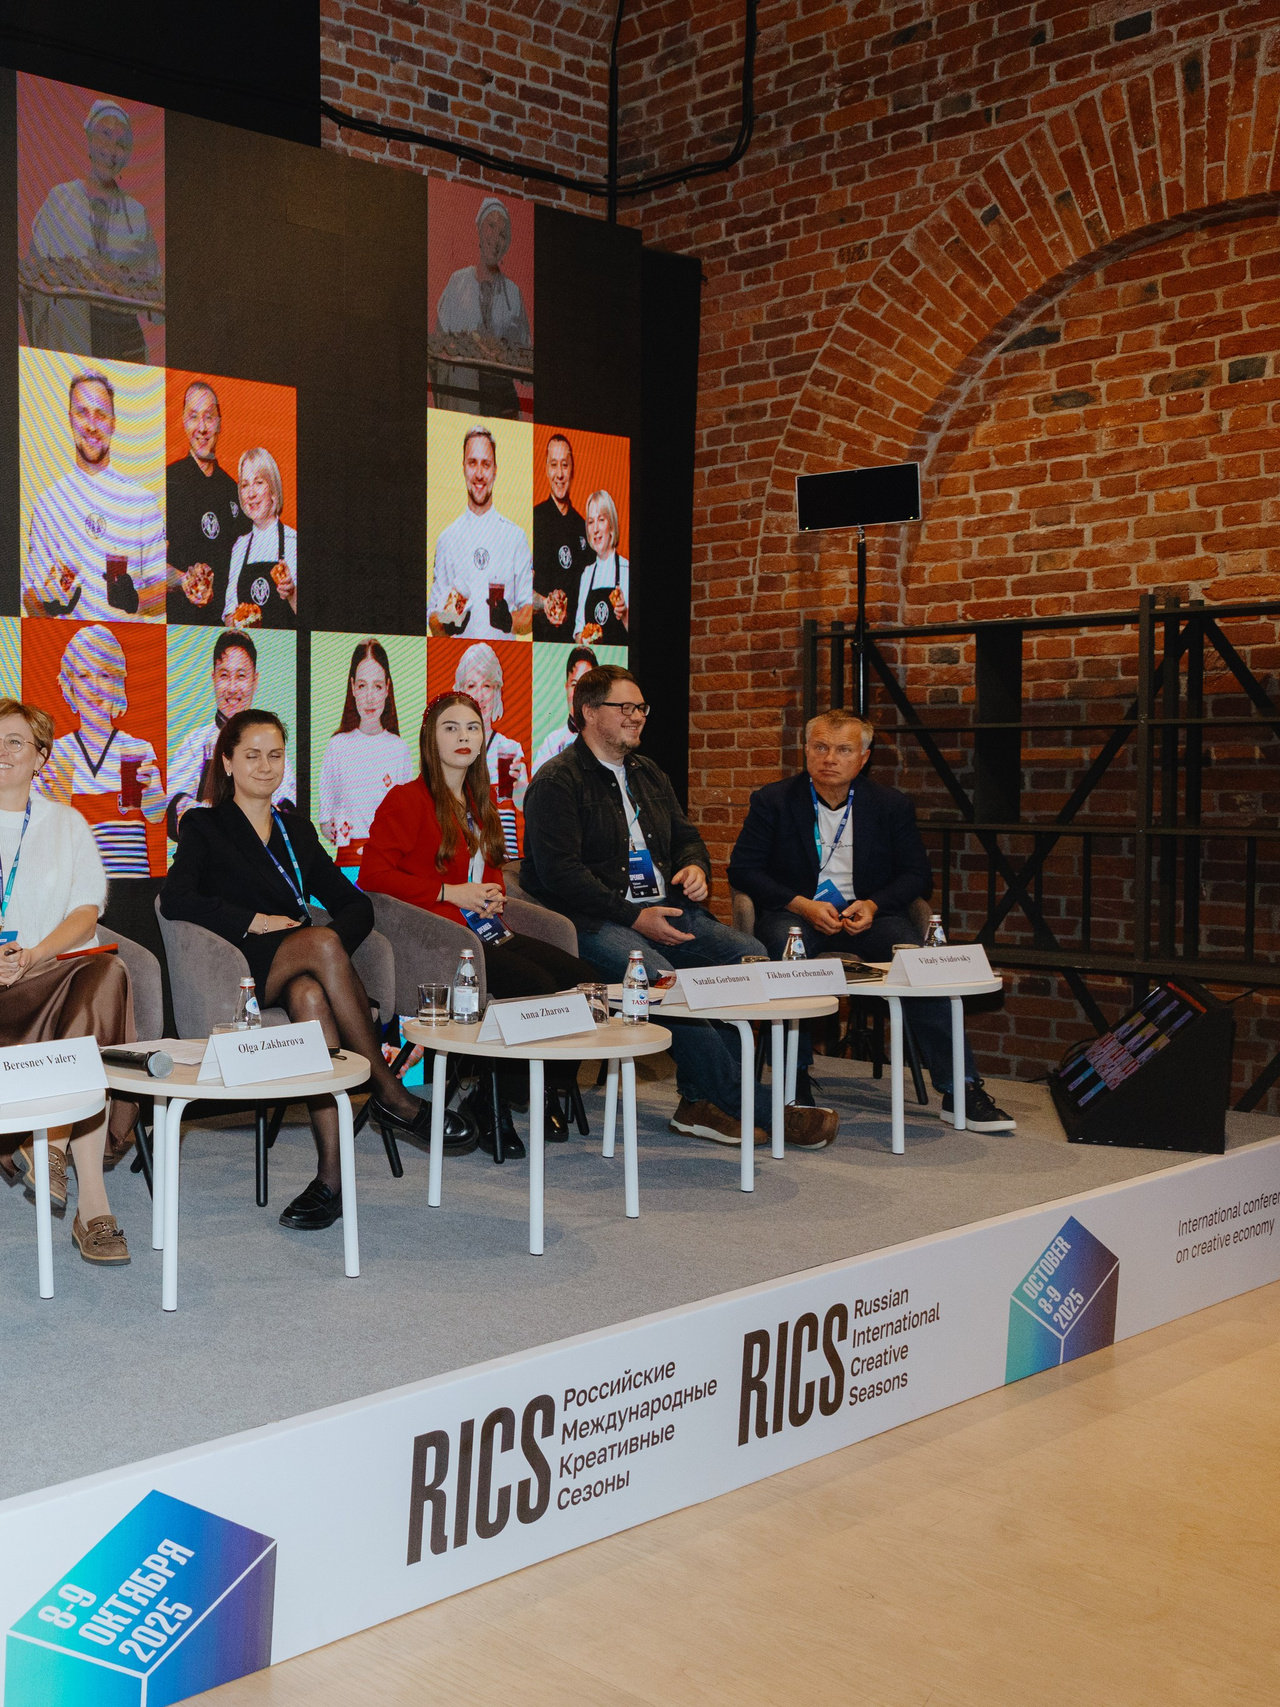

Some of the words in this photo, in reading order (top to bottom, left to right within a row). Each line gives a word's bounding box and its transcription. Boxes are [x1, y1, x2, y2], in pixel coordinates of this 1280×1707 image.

[692, 976, 716, 987] Natalia
[716, 974, 751, 985] Gorbunova
[765, 971, 791, 980] Tikhon
[792, 968, 835, 978] Grebennikov
[918, 956, 939, 966] Vitaly
[939, 954, 971, 964] Svidovsky
[520, 1011, 540, 1021] Anna
[540, 1005, 570, 1018] Zharova
[2, 1056, 44, 1072] Beresnev
[46, 1052, 77, 1066] Valery
[238, 1042, 259, 1055] Olga
[260, 1036, 305, 1050] Zakharova
[1178, 1201, 1241, 1237] International
[1176, 1247, 1189, 1264] on
[1191, 1233, 1231, 1258] creative
[1233, 1218, 1276, 1244] economy
[1022, 1235, 1072, 1300] OCTOBER
[853, 1288, 909, 1320] Russian
[1037, 1285, 1062, 1315] 8-9
[1052, 1287, 1085, 1330] 2025
[852, 1302, 941, 1349] International
[737, 1302, 849, 1447] RICS
[850, 1344, 909, 1377] Creative
[563, 1361, 676, 1412] Российские
[848, 1372, 909, 1407] Seasons
[561, 1379, 718, 1446] Международные
[559, 1423, 676, 1479] Креативные
[406, 1394, 557, 1567] RICS
[556, 1470, 631, 1511] Сезоны
[37, 1583, 97, 1630] 8-9
[78, 1538, 195, 1647] ОКТЯБРЯ
[118, 1597, 194, 1664] 2025
